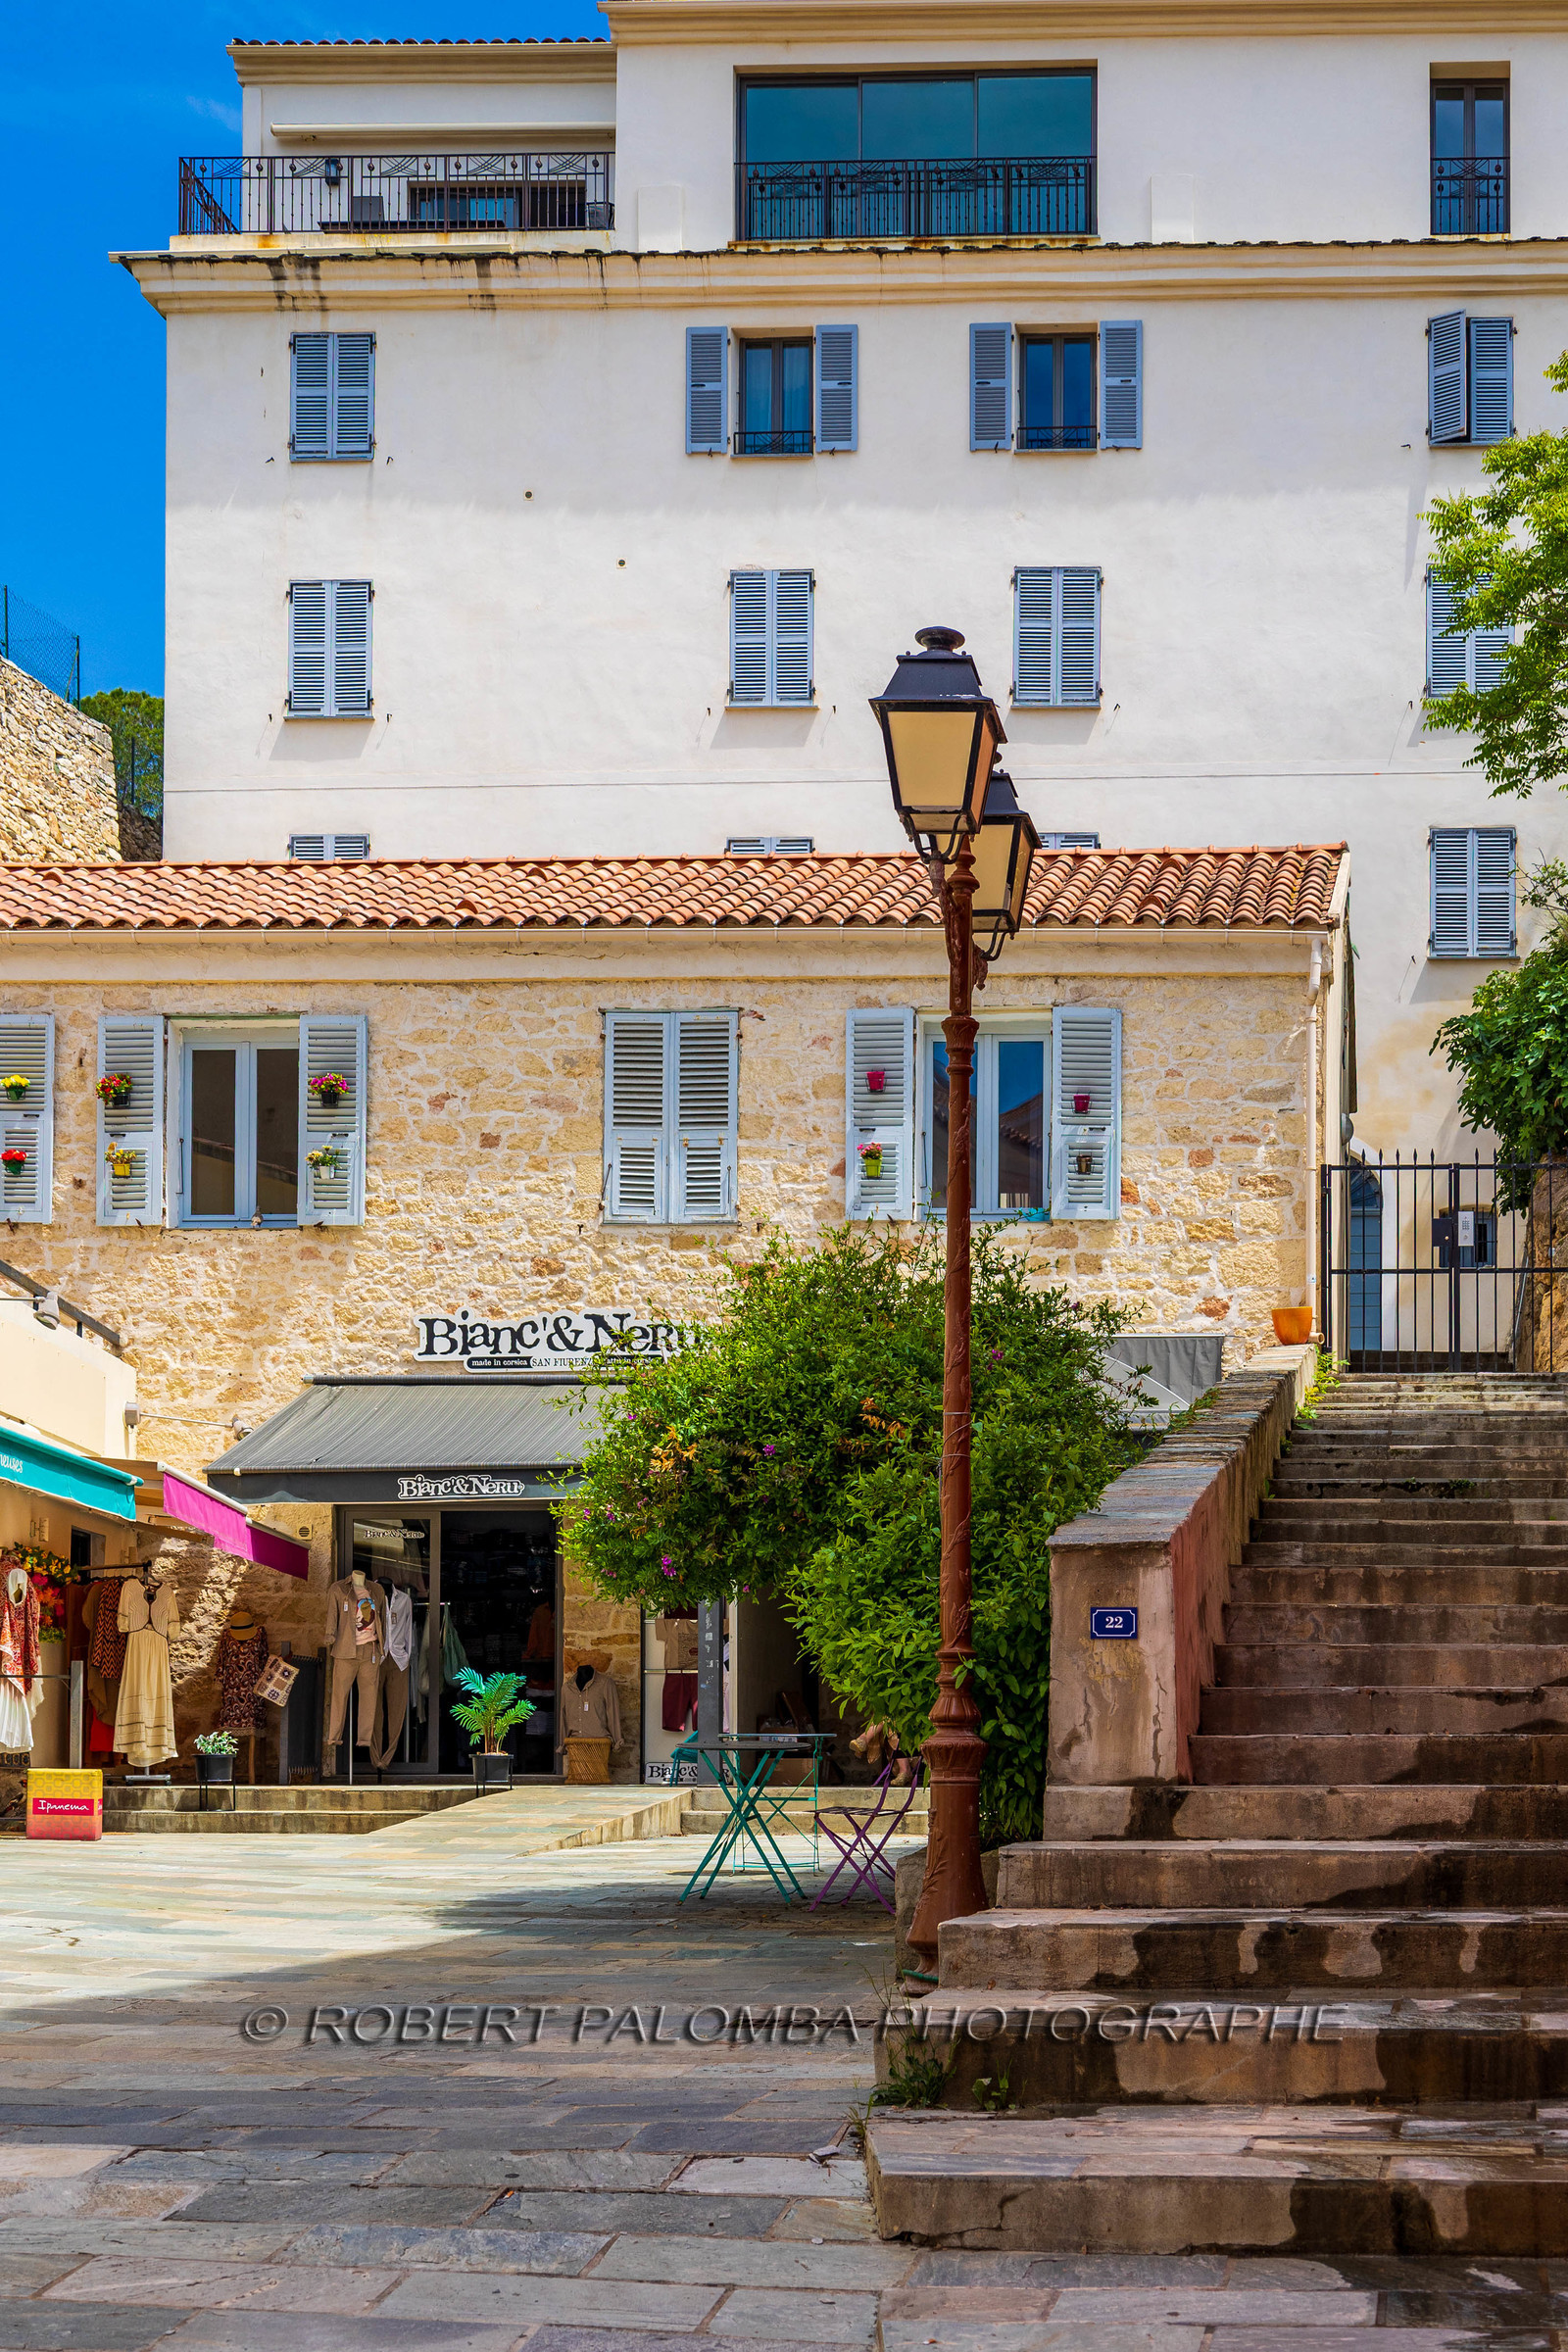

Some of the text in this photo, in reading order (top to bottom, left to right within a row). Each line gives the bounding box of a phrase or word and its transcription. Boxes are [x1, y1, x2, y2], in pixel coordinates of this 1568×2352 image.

[532, 1357, 595, 1368] SAN FIURENZ
[1105, 1616, 1123, 1629] 22
[37, 1799, 90, 1813] Ipanema
